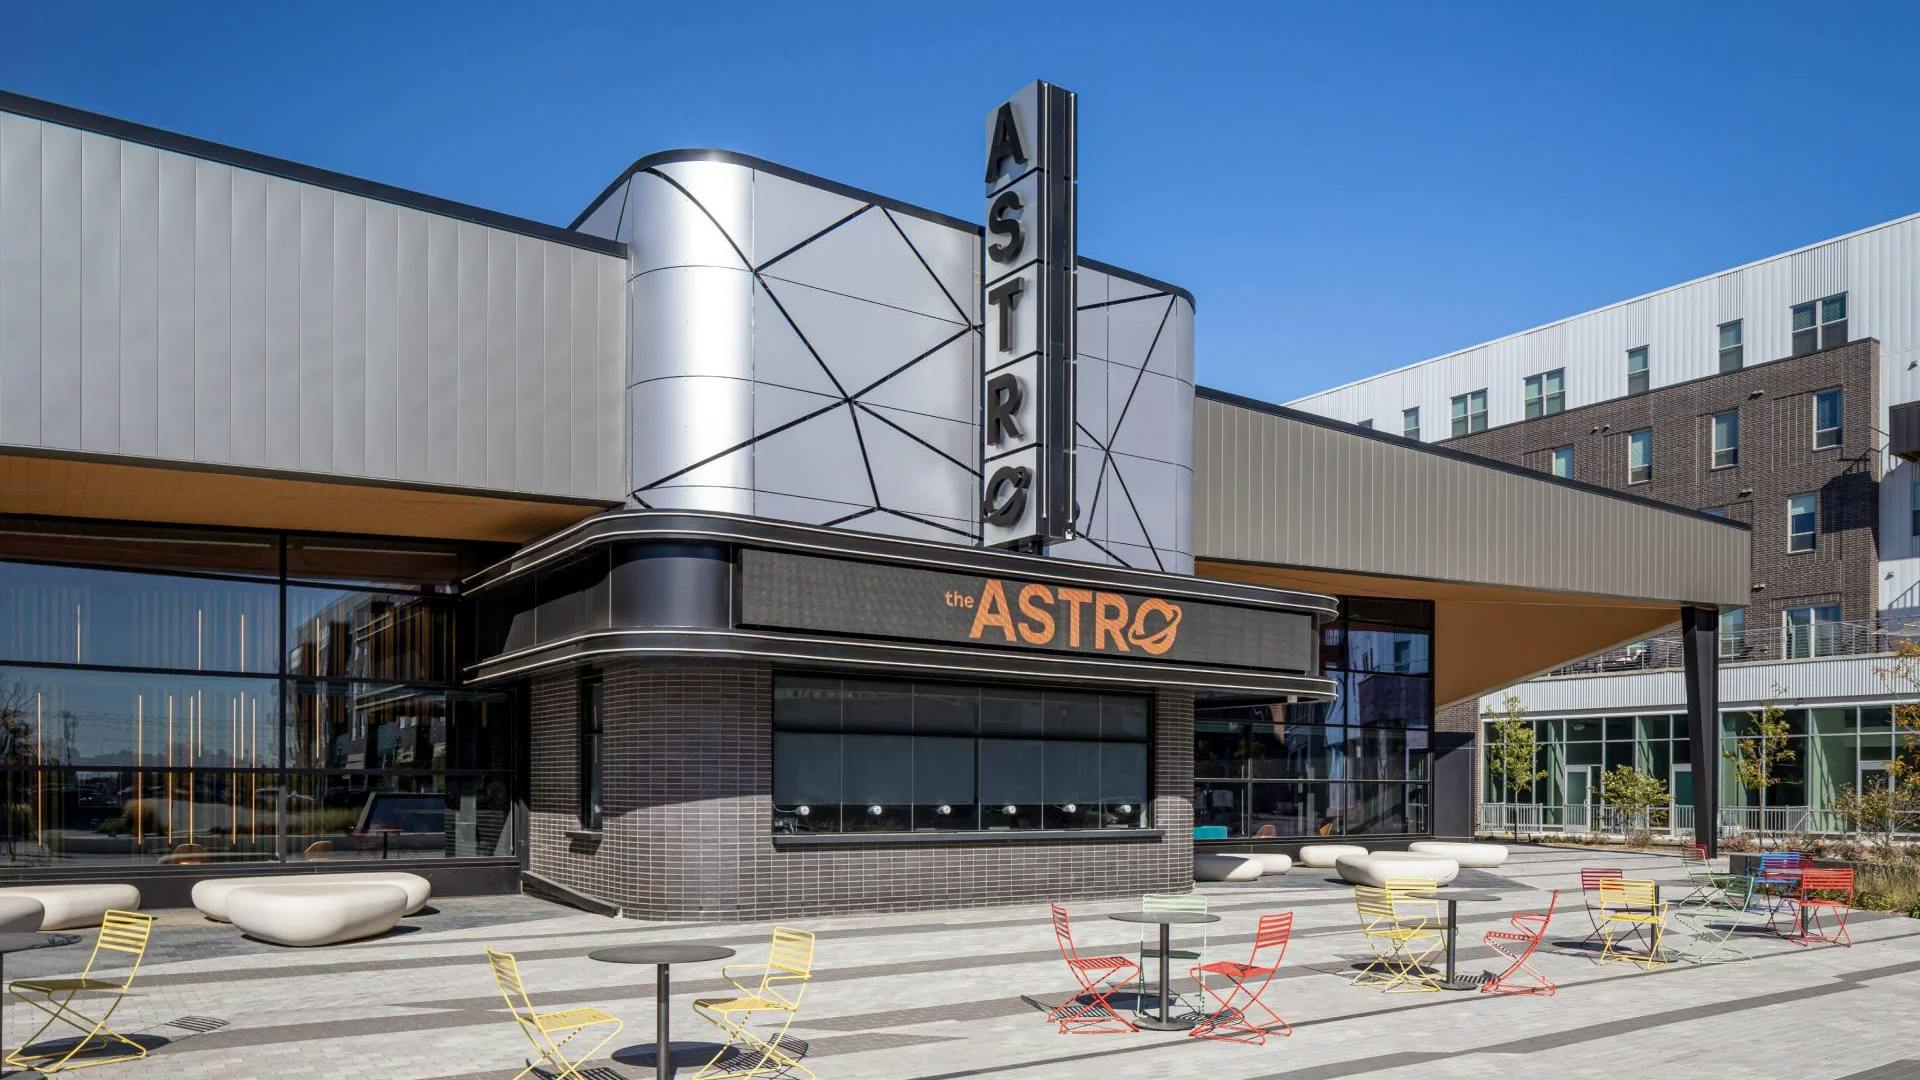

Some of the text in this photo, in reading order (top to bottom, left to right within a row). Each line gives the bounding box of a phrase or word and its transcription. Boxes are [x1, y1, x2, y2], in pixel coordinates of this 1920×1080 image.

[984, 101, 1030, 528] ASTRO
[944, 579, 1183, 656] the ASTRO
